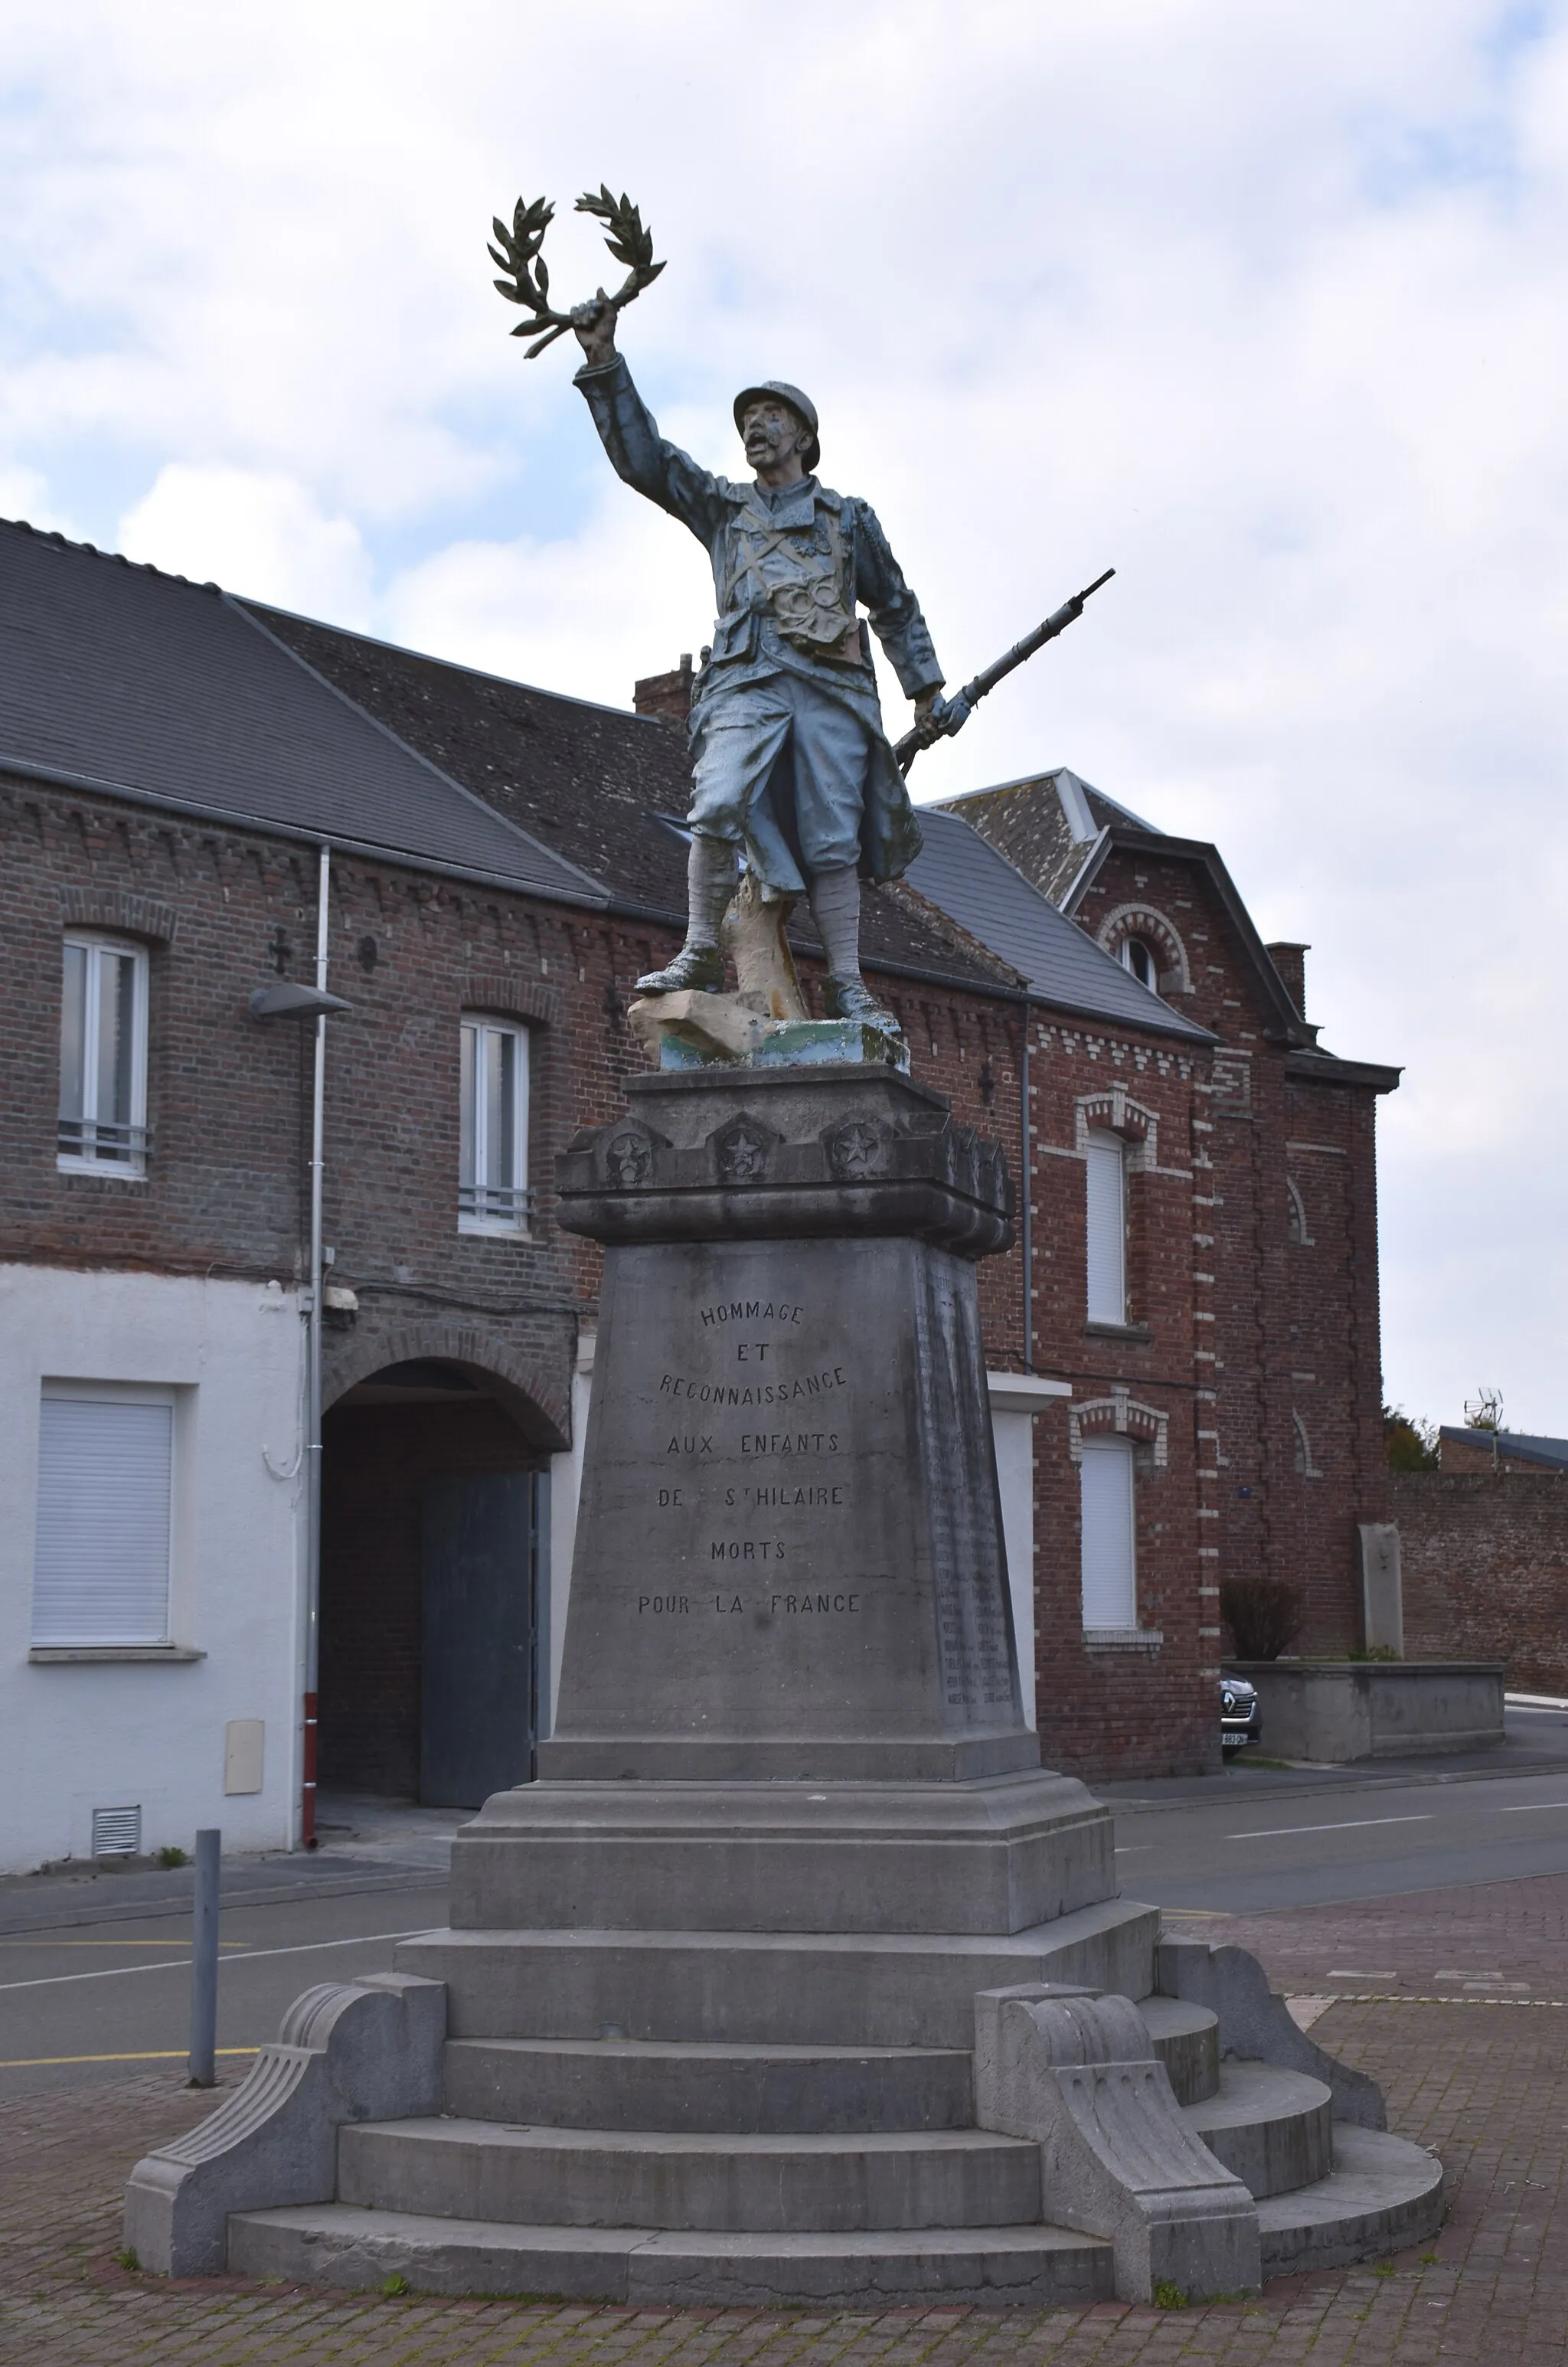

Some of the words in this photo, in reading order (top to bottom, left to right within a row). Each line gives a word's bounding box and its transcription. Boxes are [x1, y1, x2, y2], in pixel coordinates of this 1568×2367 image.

[701, 1301, 805, 1326] HOMMAGE
[737, 1344, 769, 1361] ET
[660, 1367, 847, 1405] RECONNAISSANCE
[668, 1436, 712, 1453] AUX
[741, 1434, 838, 1453] ENFANTS
[658, 1489, 682, 1506] DE
[711, 1541, 786, 1560] MORTS
[639, 1596, 689, 1613] POUR
[716, 1596, 743, 1613] LA
[771, 1594, 860, 1613] FRANCE
